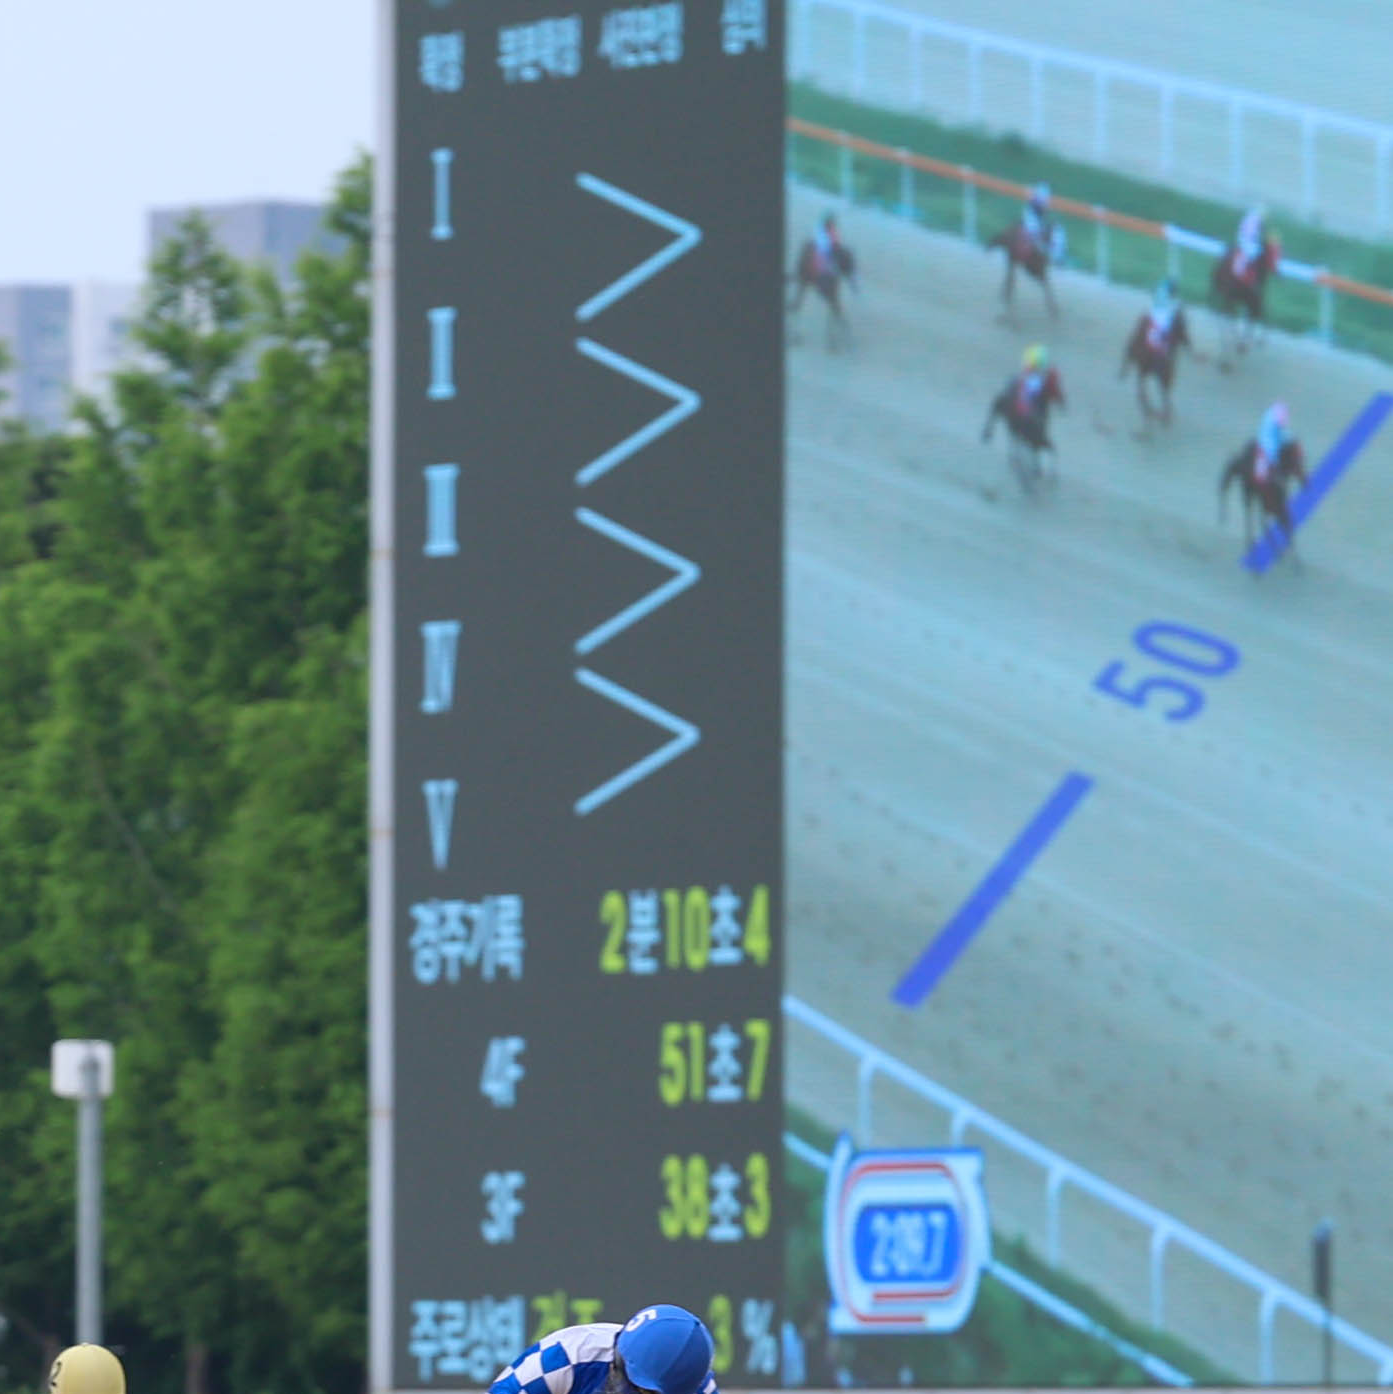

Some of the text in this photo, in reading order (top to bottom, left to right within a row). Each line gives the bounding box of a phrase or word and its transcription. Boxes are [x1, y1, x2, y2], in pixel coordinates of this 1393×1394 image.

[1092, 619, 1241, 724] 50
[410, 894, 527, 984] 경주기록
[658, 1018, 772, 1106] 51초7
